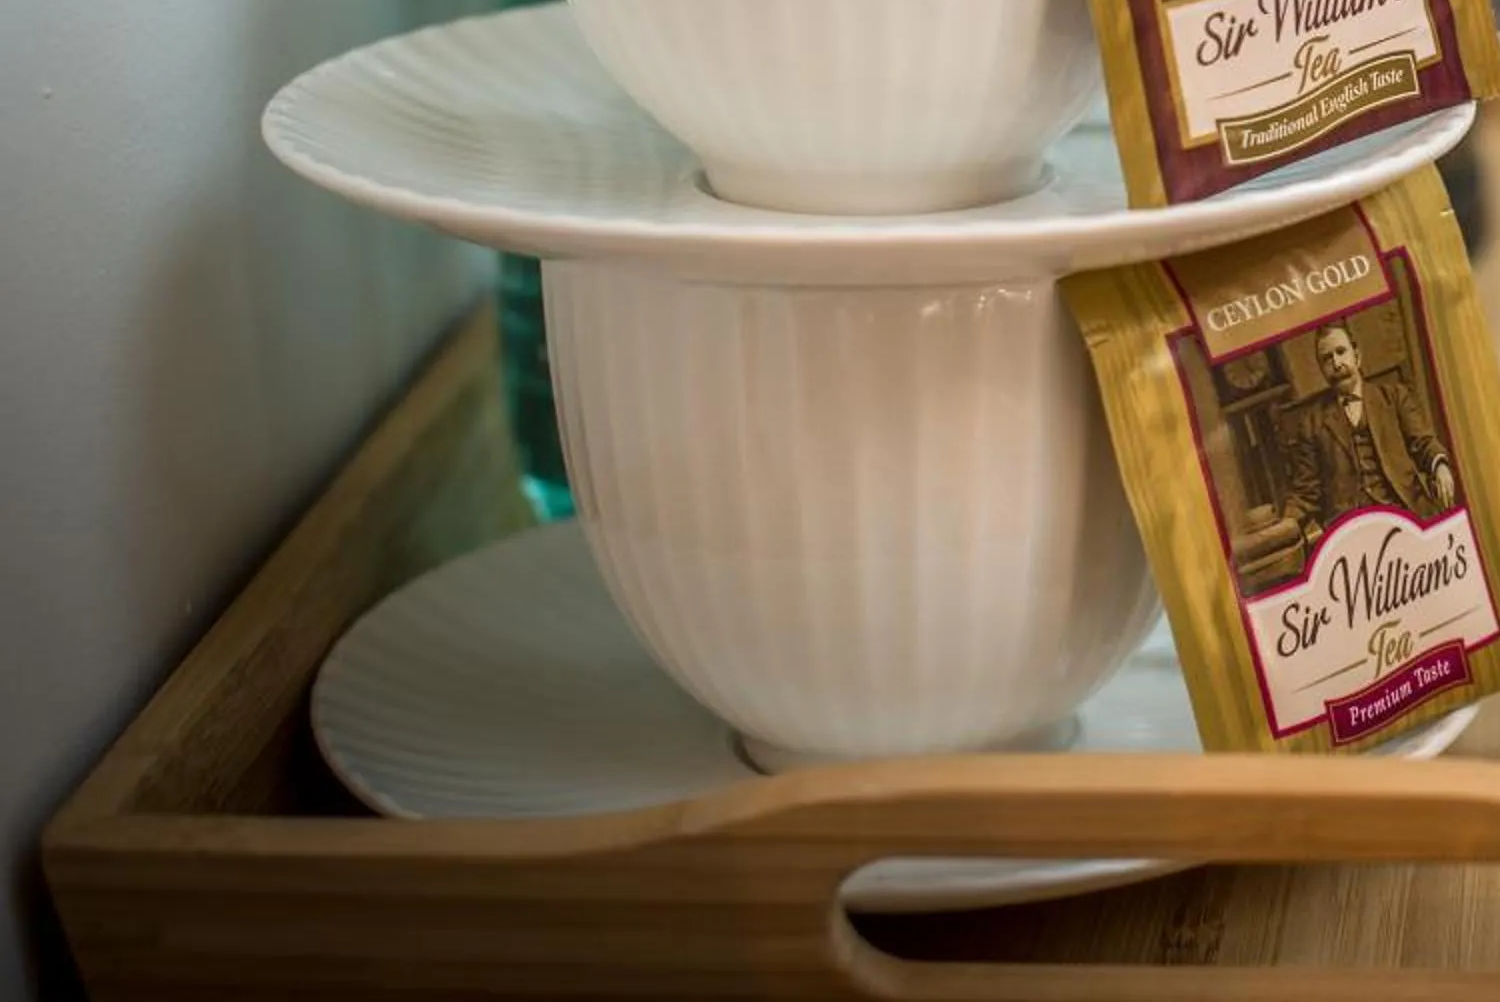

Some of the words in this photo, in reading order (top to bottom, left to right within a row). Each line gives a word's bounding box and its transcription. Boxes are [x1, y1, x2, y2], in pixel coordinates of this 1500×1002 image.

[1196, 12, 1259, 66] Sir
[1293, 34, 1342, 94] Tea
[1240, 110, 1319, 149] Traditional
[1318, 80, 1369, 119] English
[1368, 69, 1403, 94] Taste
[1206, 276, 1306, 333] CEYLON
[1306, 254, 1370, 295] GOLD
[1276, 602, 1331, 658] Sir
[1328, 526, 1468, 630] William's
[1367, 620, 1415, 679] Tea
[1349, 683, 1413, 727] Premium
[1413, 658, 1451, 689] Taste
